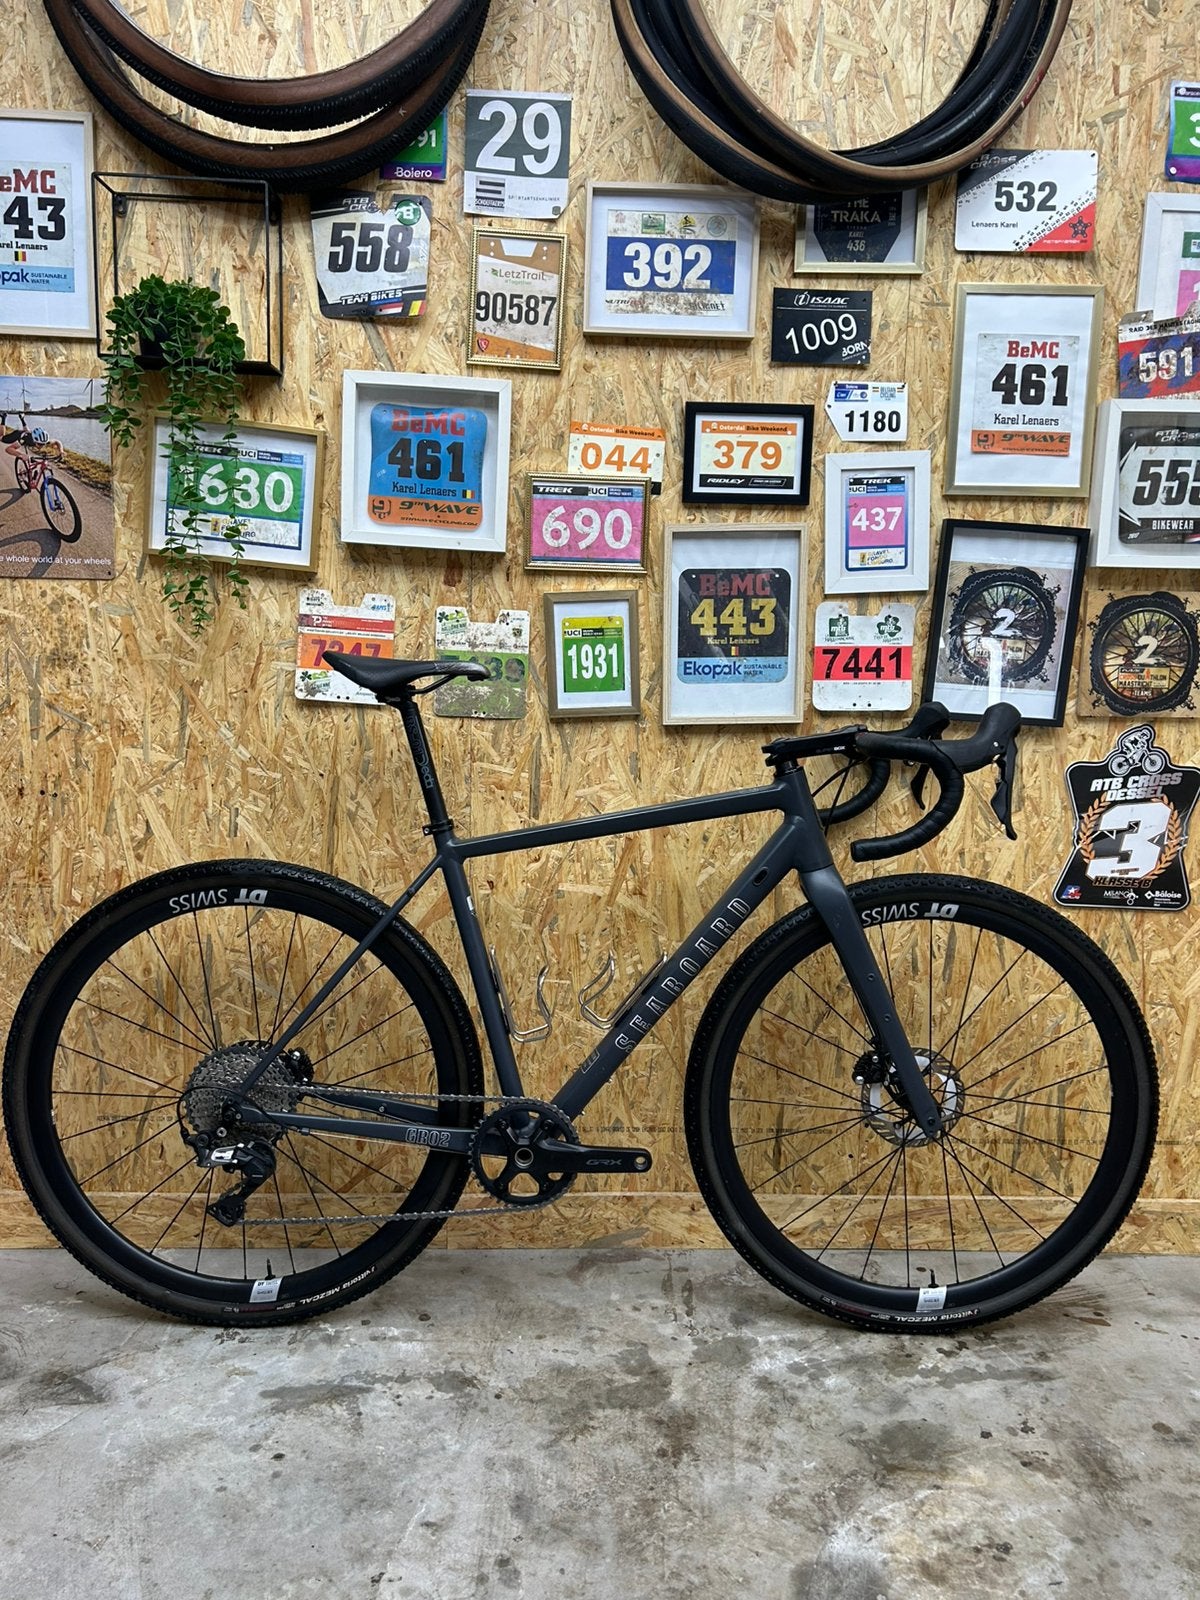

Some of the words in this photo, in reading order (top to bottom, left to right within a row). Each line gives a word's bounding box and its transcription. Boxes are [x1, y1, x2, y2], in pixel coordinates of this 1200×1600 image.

[409, 129, 436, 148] 91
[476, 100, 562, 176] 29
[394, 166, 433, 178] Bolero
[994, 181, 1058, 212] 532
[831, 210, 881, 223] TRAKA
[971, 220, 999, 228] Lenaers
[1000, 220, 1019, 228] Karel
[15, 241, 48, 250] Lenaers
[327, 221, 414, 273] 558
[846, 239, 866, 251] 436
[499, 268, 546, 281] LetzTrail
[623, 241, 712, 290] 392
[0, 268, 30, 285] pak
[341, 293, 369, 305] TEAM
[370, 289, 403, 301] BIKES
[809, 296, 850, 305] ISAAC
[475, 291, 557, 326] 90587
[785, 313, 857, 354] 1009
[1006, 340, 1060, 359] BeMC
[1138, 346, 1193, 383] 591
[991, 363, 1069, 406] 461
[391, 408, 466, 437] BeMC
[845, 410, 901, 433] 1180
[993, 413, 1019, 425] Karel
[1021, 414, 1060, 426] Lenaers
[240, 450, 256, 458] UCI
[387, 437, 465, 483] 461
[581, 442, 652, 474] 044
[713, 440, 782, 470] 379
[392, 481, 417, 493] Karel
[420, 483, 457, 497] Lenaers
[537, 486, 573, 494] TREK
[591, 487, 607, 495] UCI
[707, 477, 745, 485] RIDLEY
[542, 505, 633, 551] 690
[852, 506, 903, 531] 437
[1151, 519, 1194, 530] BIKEWEAR
[6, 555, 30, 563] whole
[32, 556, 53, 564] world
[64, 558, 82, 566] your
[83, 556, 112, 565] wheels
[699, 573, 771, 596] BeMC
[690, 598, 777, 636] 443
[990, 608, 1023, 637] 2
[707, 637, 728, 645] Karel
[729, 637, 760, 645] Lenaers
[1132, 635, 1167, 664] 2
[567, 643, 618, 679] 1931
[683, 661, 742, 679] Ekopak
[821, 647, 902, 679] 7441
[1090, 777, 1123, 792] ATB
[1126, 772, 1183, 789] CROSS
[1105, 785, 1164, 802] DESSEL
[1085, 802, 1173, 880] 3
[1092, 875, 1140, 888] KLASSE
[169, 888, 228, 914] SWISS
[234, 888, 268, 904] DT
[861, 902, 920, 926] SWISS
[923, 902, 960, 919] DT
[586, 1158, 622, 1166] GRX
[300, 1286, 342, 1305] MEZCAL
[894, 1315, 939, 1323] MEZCAL
